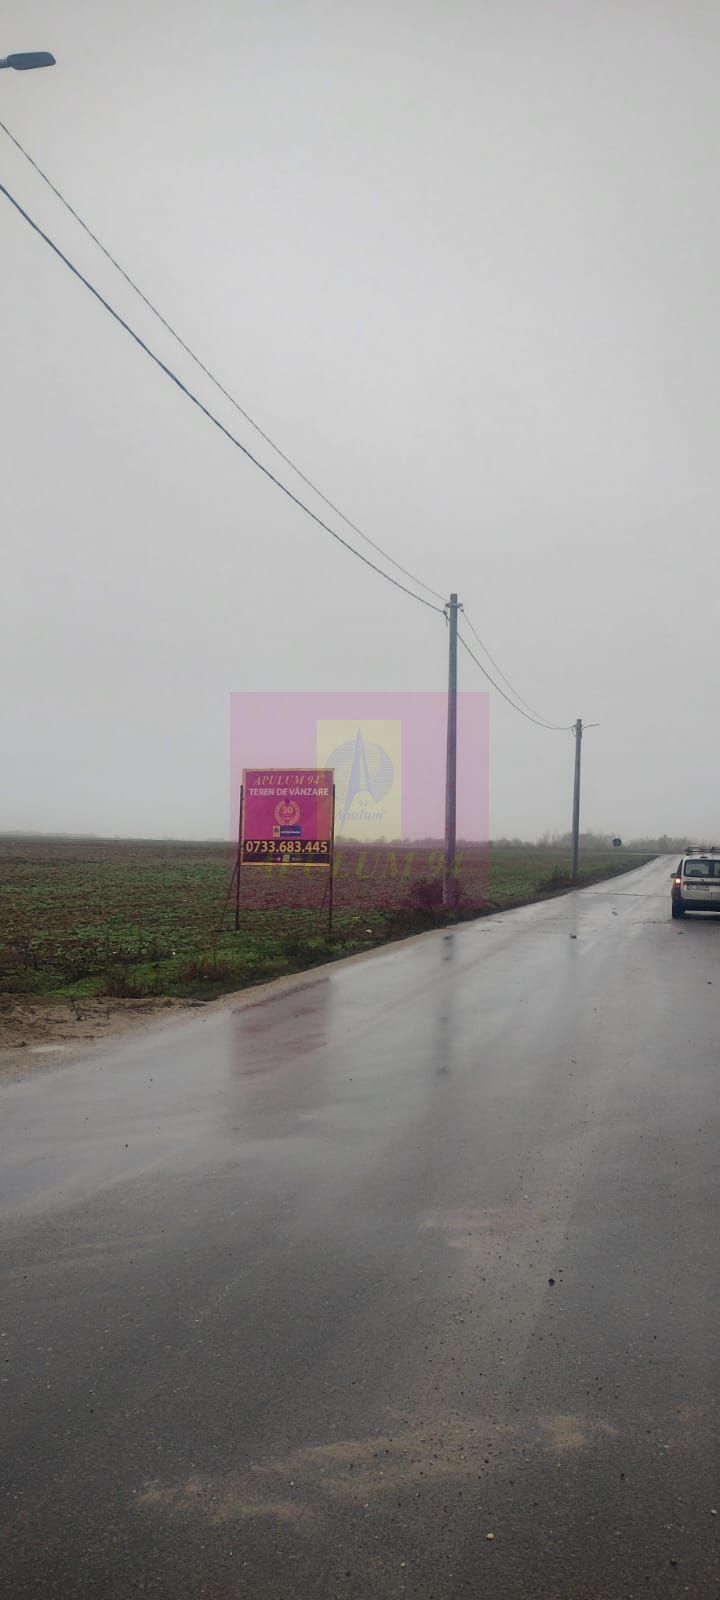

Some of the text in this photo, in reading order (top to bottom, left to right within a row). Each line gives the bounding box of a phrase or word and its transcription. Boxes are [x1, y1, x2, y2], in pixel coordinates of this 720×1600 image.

[254, 775, 305, 786] APULUM
[248, 785, 329, 797] TEREN DE VÂNZARE
[245, 840, 328, 853] 0733.683.445
